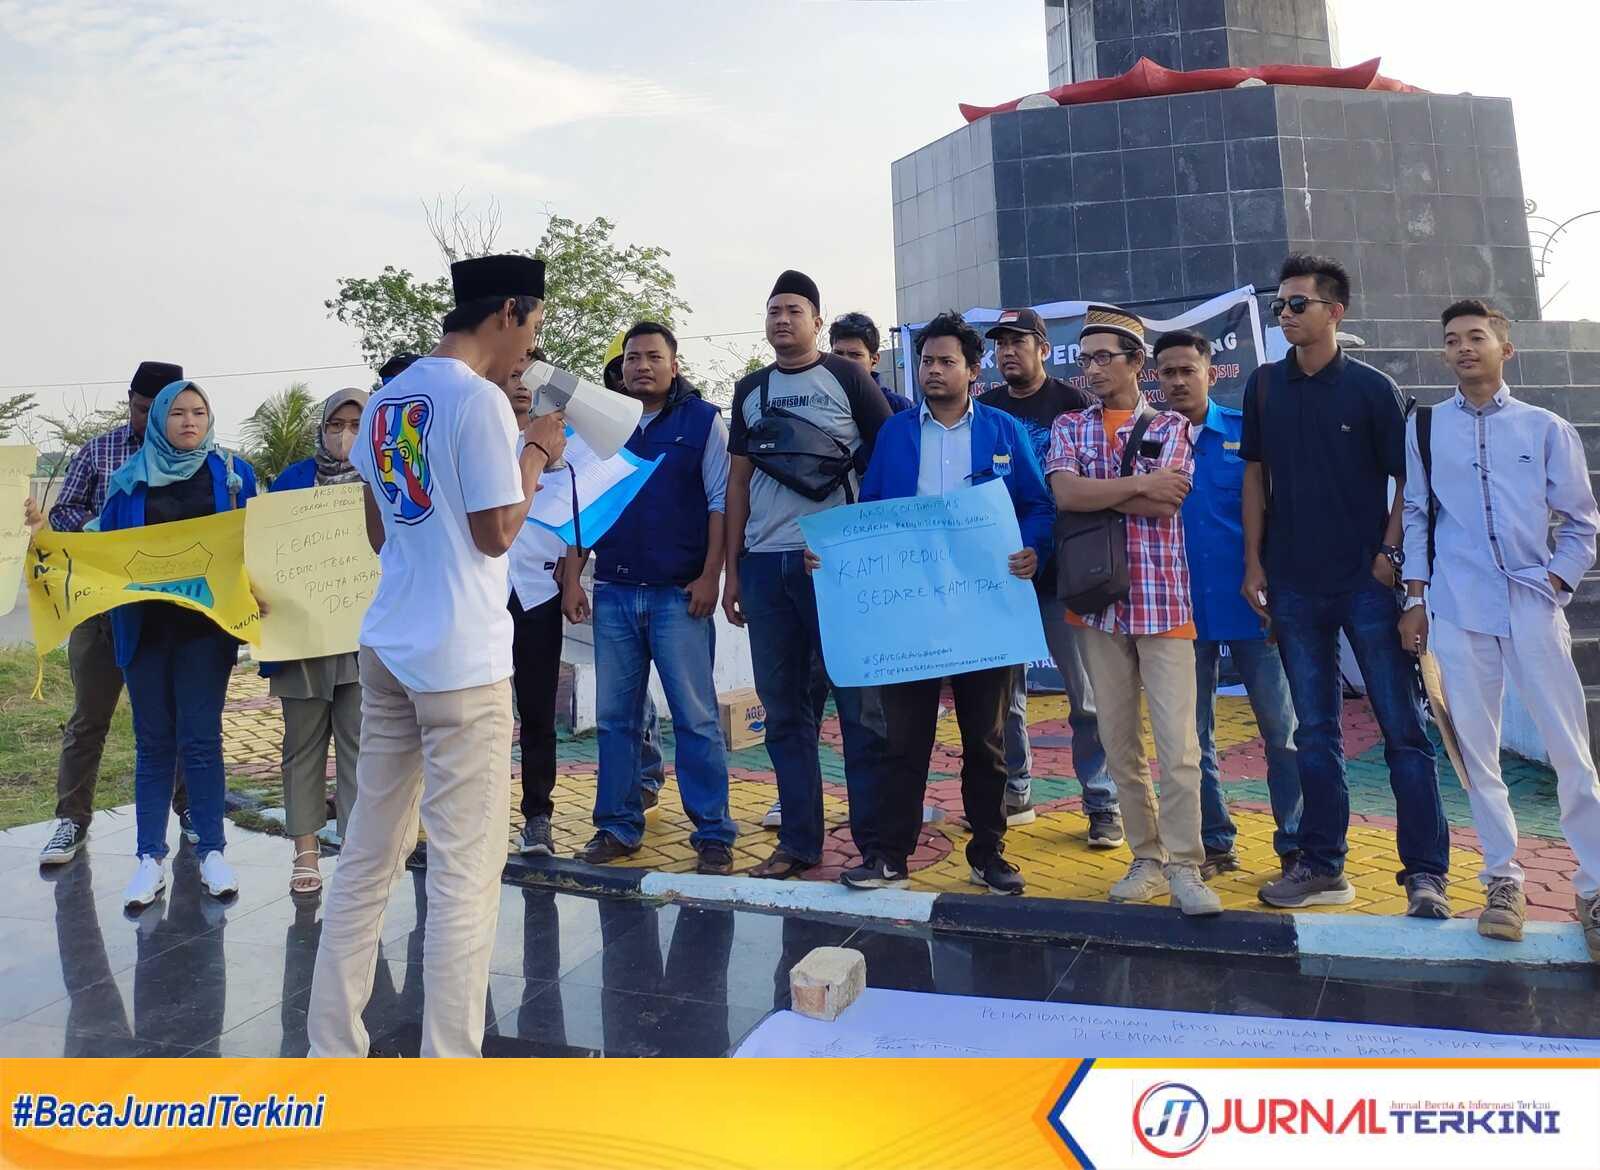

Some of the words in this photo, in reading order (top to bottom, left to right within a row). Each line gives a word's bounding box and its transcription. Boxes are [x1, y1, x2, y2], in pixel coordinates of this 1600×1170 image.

[839, 553, 891, 584] KAMI
[857, 586, 930, 615] SEDARE
[934, 578, 970, 597] KAMI
